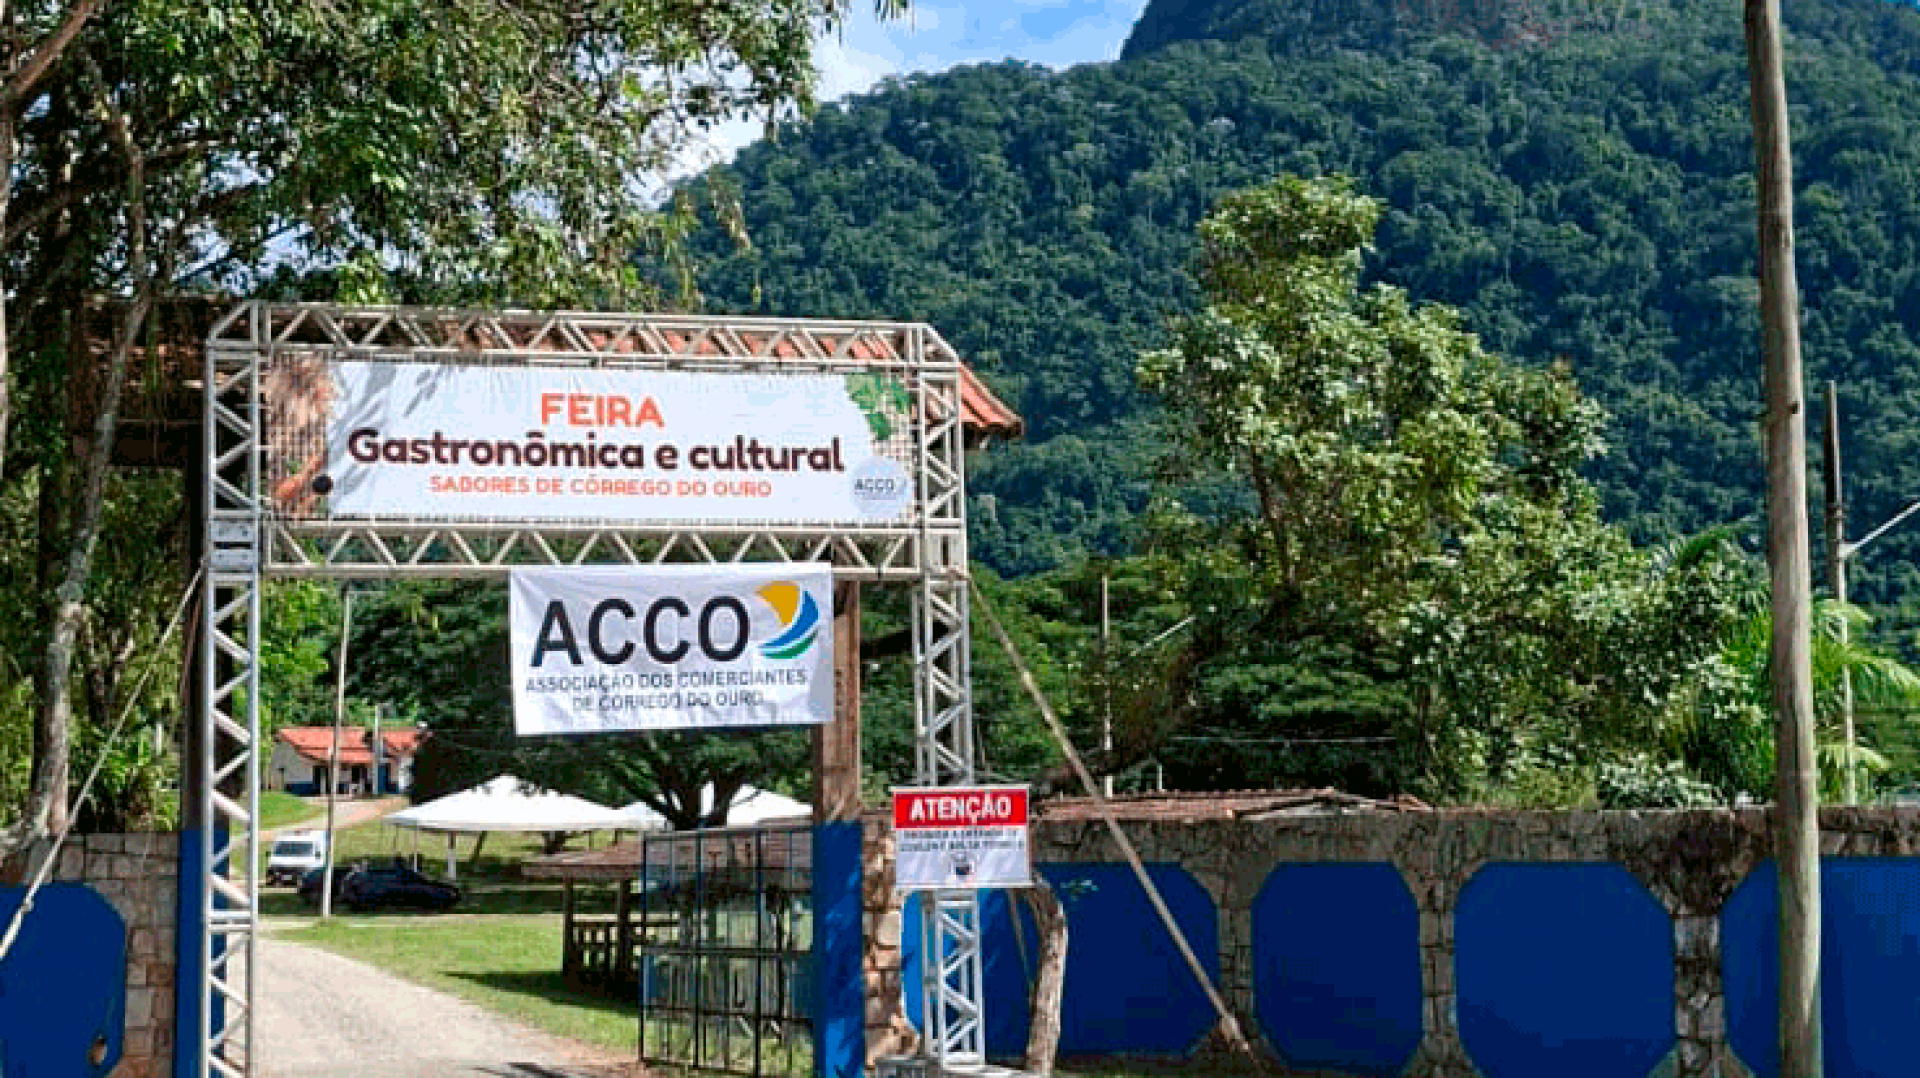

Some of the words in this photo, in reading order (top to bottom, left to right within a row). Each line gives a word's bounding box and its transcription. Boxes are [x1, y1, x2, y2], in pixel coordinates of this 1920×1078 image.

[541, 393, 665, 428] FEIRA
[348, 427, 644, 468] Gastronômica
[655, 444, 679, 470] e
[688, 434, 845, 471] cultural
[429, 475, 530, 493] SABORES
[536, 477, 564, 493] DE
[677, 480, 707, 496] DO
[713, 481, 772, 497] OURO
[854, 478, 894, 492] ACCO
[530, 596, 750, 667] ACCO
[638, 673, 673, 688] DOS
[677, 669, 808, 688] COMERCIANTES
[572, 697, 594, 711] DE
[687, 692, 710, 707] DO
[716, 690, 764, 707] OURO
[909, 793, 1012, 824] ATENÇÃO
